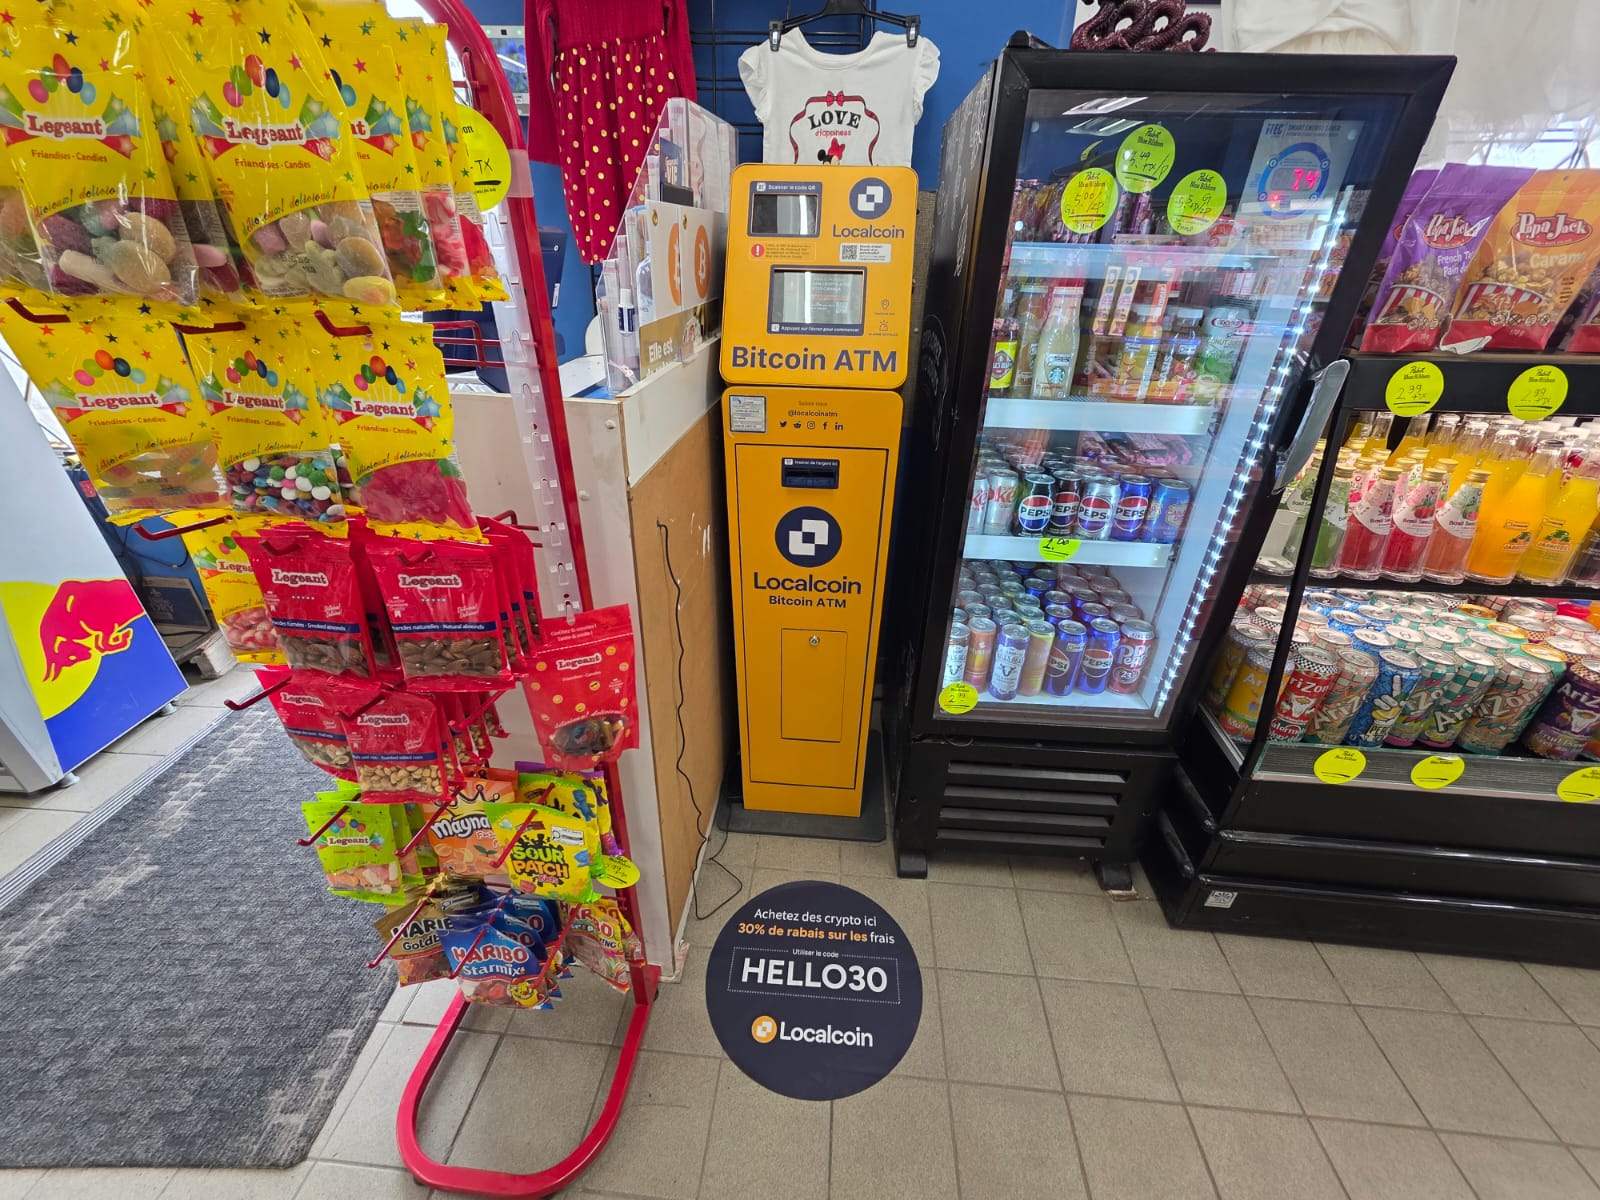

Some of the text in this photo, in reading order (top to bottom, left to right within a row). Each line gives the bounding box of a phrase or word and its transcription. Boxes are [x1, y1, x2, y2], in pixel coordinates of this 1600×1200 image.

[26, 114, 103, 138] Legeant
[807, 110, 862, 130] LOVE
[225, 121, 304, 146] Legeant
[31, 149, 108, 162] Friandises Candies
[234, 158, 311, 169] Friandises Candies
[1291, 168, 1320, 191] 74
[832, 224, 905, 239] Localcoin
[1518, 213, 1587, 240] Papa Jack
[1437, 250, 1462, 265] French
[648, 336, 673, 363] Elle est
[732, 346, 897, 372] Bitcoin ATM
[78, 393, 159, 409] Legeant
[224, 391, 285, 409] Legeant
[353, 400, 415, 416] Legeant
[788, 409, 838, 417] @localcoinatm
[1020, 506, 1051, 517] PEPS
[273, 570, 327, 585] Legeant
[400, 575, 460, 588] Legeant
[753, 571, 862, 595] Localcoin
[769, 595, 847, 609] Bitcoin ATM
[557, 654, 601, 670] Legeant
[358, 714, 408, 726] Legeant
[329, 837, 369, 845] Legeant
[512, 846, 564, 864] SOUR
[513, 860, 569, 878] PATCH
[754, 908, 877, 927] Achetez des crypto ici
[738, 922, 895, 944] 30% de rabais sur les frais
[451, 943, 530, 963] HARIBO
[792, 948, 815, 956] Utiliser
[822, 950, 839, 958] code
[462, 963, 523, 977] Starmix
[741, 957, 888, 993] HELLO30
[779, 1021, 873, 1047] Localcoin
